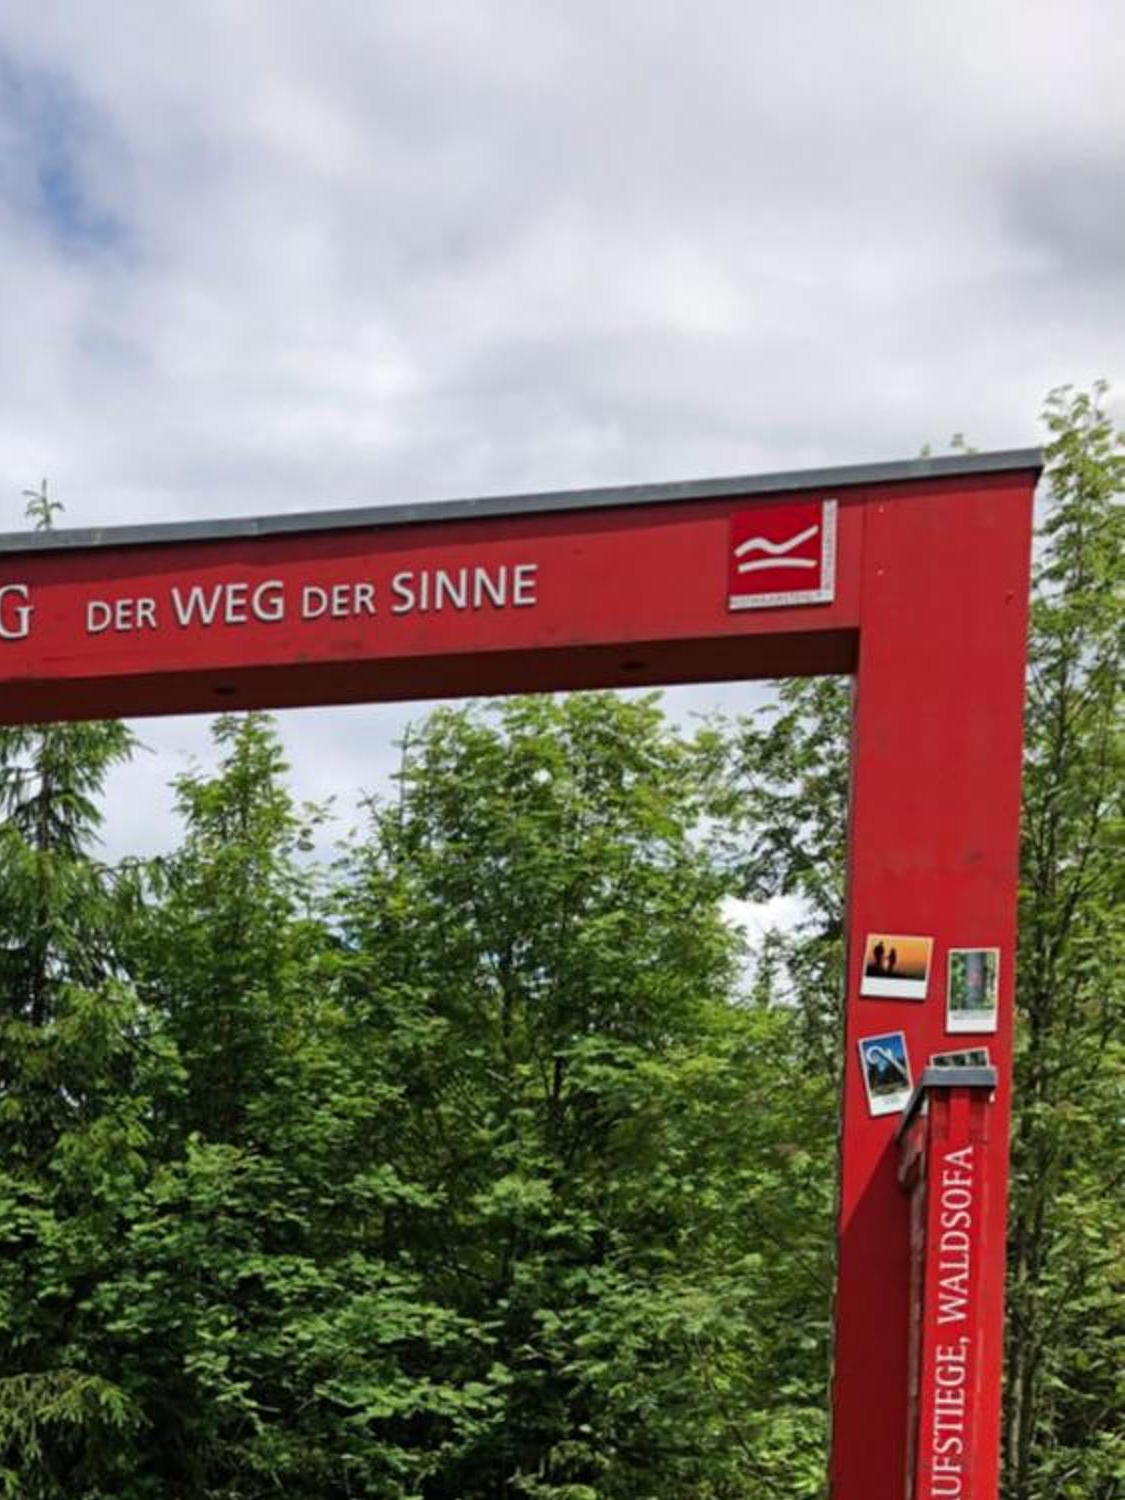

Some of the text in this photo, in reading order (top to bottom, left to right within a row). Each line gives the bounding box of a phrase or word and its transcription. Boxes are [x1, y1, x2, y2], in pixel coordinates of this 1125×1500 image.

[85, 598, 158, 633] DER
[171, 580, 285, 626] WEG
[301, 582, 376, 619] DER
[390, 563, 540, 614] SINNE
[938, 1146, 974, 1325] WALDSOFA
